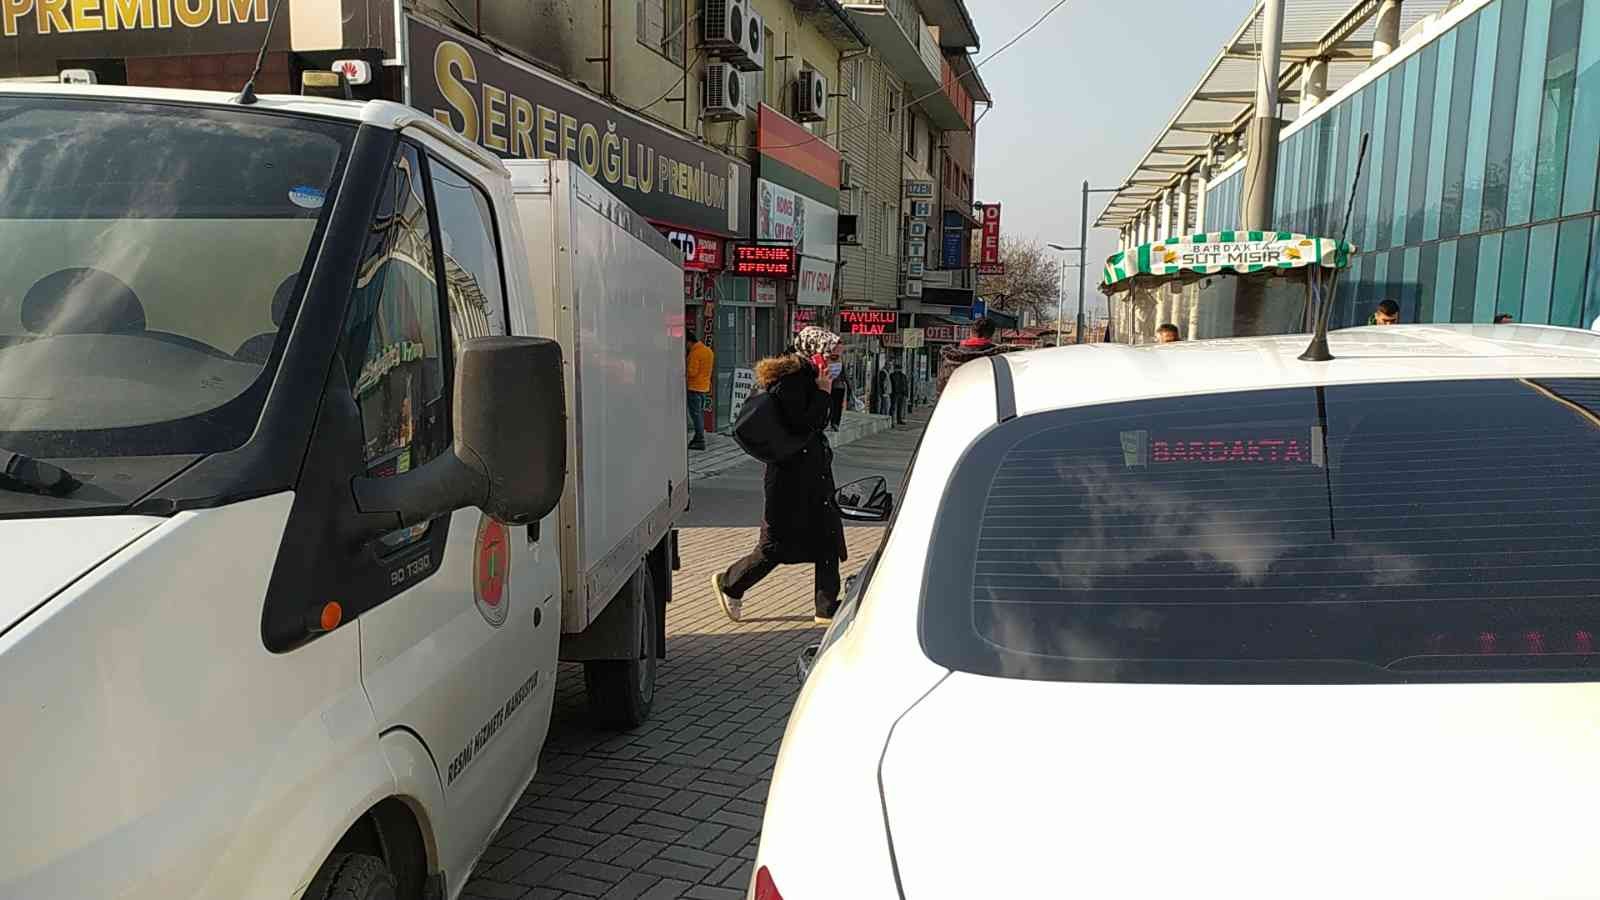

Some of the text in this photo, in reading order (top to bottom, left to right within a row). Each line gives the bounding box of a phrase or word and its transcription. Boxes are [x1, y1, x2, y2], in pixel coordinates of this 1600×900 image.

[986, 207, 998, 262] OTEL
[1227, 251, 1281, 263] MISIR
[840, 311, 895, 322] TAVUKLU
[1152, 441, 1304, 461] BARDAKTA
